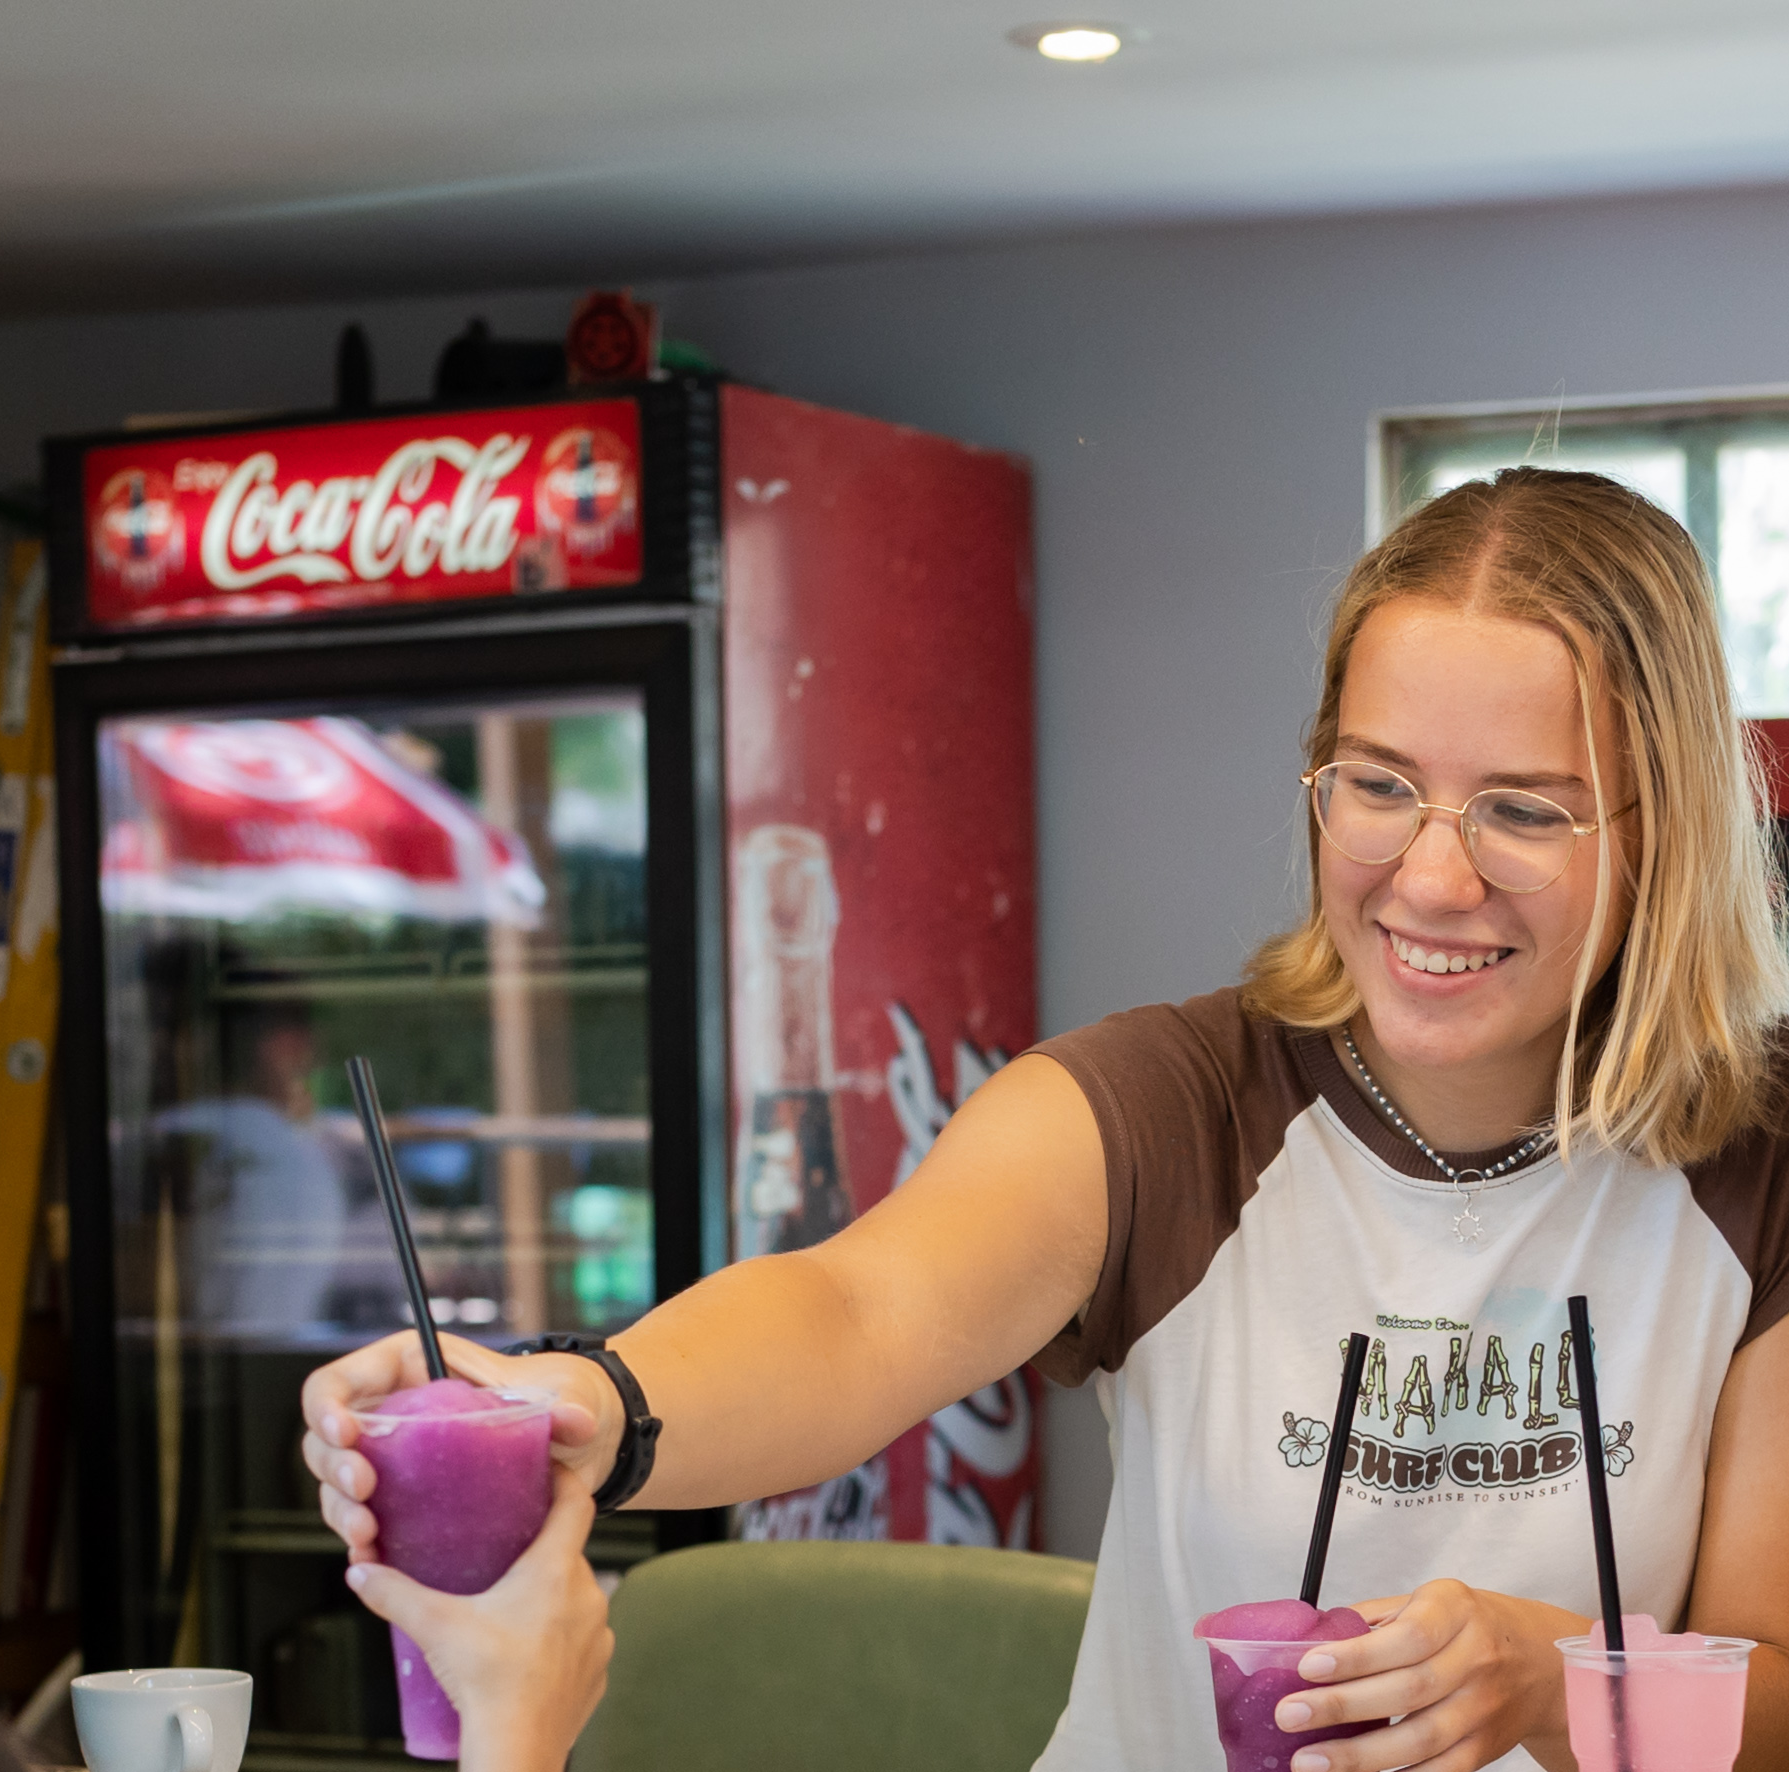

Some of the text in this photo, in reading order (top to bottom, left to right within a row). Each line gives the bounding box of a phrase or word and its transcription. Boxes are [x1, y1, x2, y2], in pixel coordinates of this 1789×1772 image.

[200, 433, 532, 589] Coca-Cola
[1376, 1314, 1432, 1330] Welcome
[1342, 1432, 1580, 1491] SURF CLUB
[1339, 1484, 1382, 1505] ROM
[1394, 1491, 1465, 1507] SUNRISE
[1474, 1493, 1490, 1503] TO
